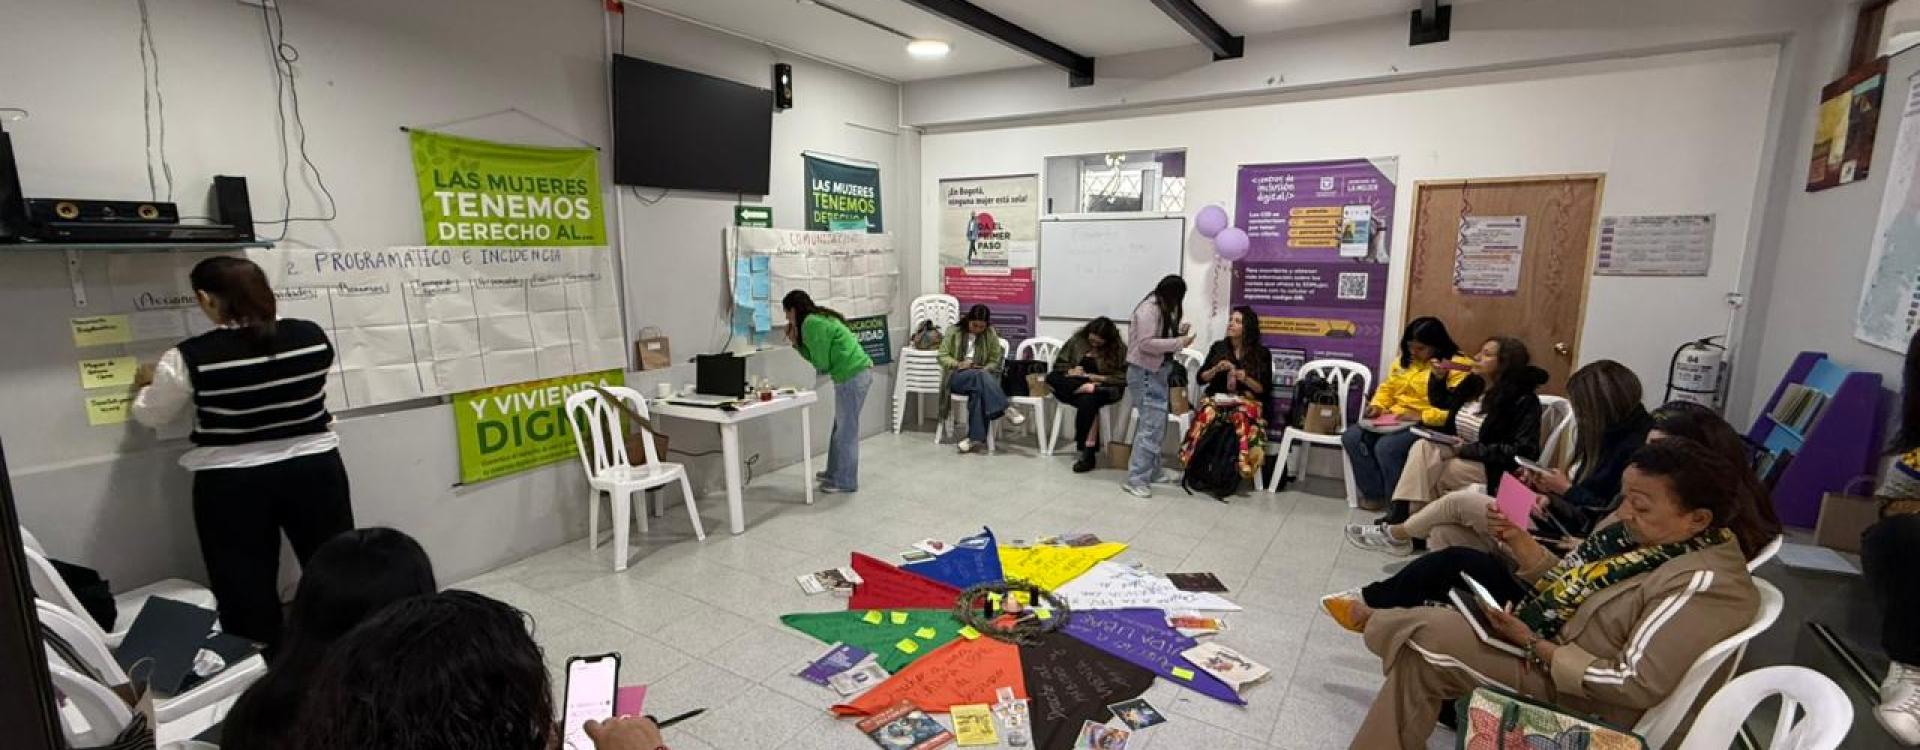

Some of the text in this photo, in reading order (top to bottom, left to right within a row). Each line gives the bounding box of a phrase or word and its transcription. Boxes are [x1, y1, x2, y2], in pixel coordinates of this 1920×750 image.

[433, 169, 588, 196] LAS MUJERES
[812, 177, 874, 199] LAS MUJERES
[434, 191, 592, 220] TENEMOS
[812, 192, 876, 214] TENEMOS
[437, 222, 594, 241] DERECHO AL...
[977, 221, 1003, 230] DA EL
[977, 231, 1011, 241] PRIMER
[977, 242, 1001, 250] PASO
[315, 249, 451, 272] PROGRAMATICO
[480, 248, 562, 265] INCIDENCIA
[470, 379, 610, 420] Y VIVIEN
[476, 406, 590, 456] DIGN
